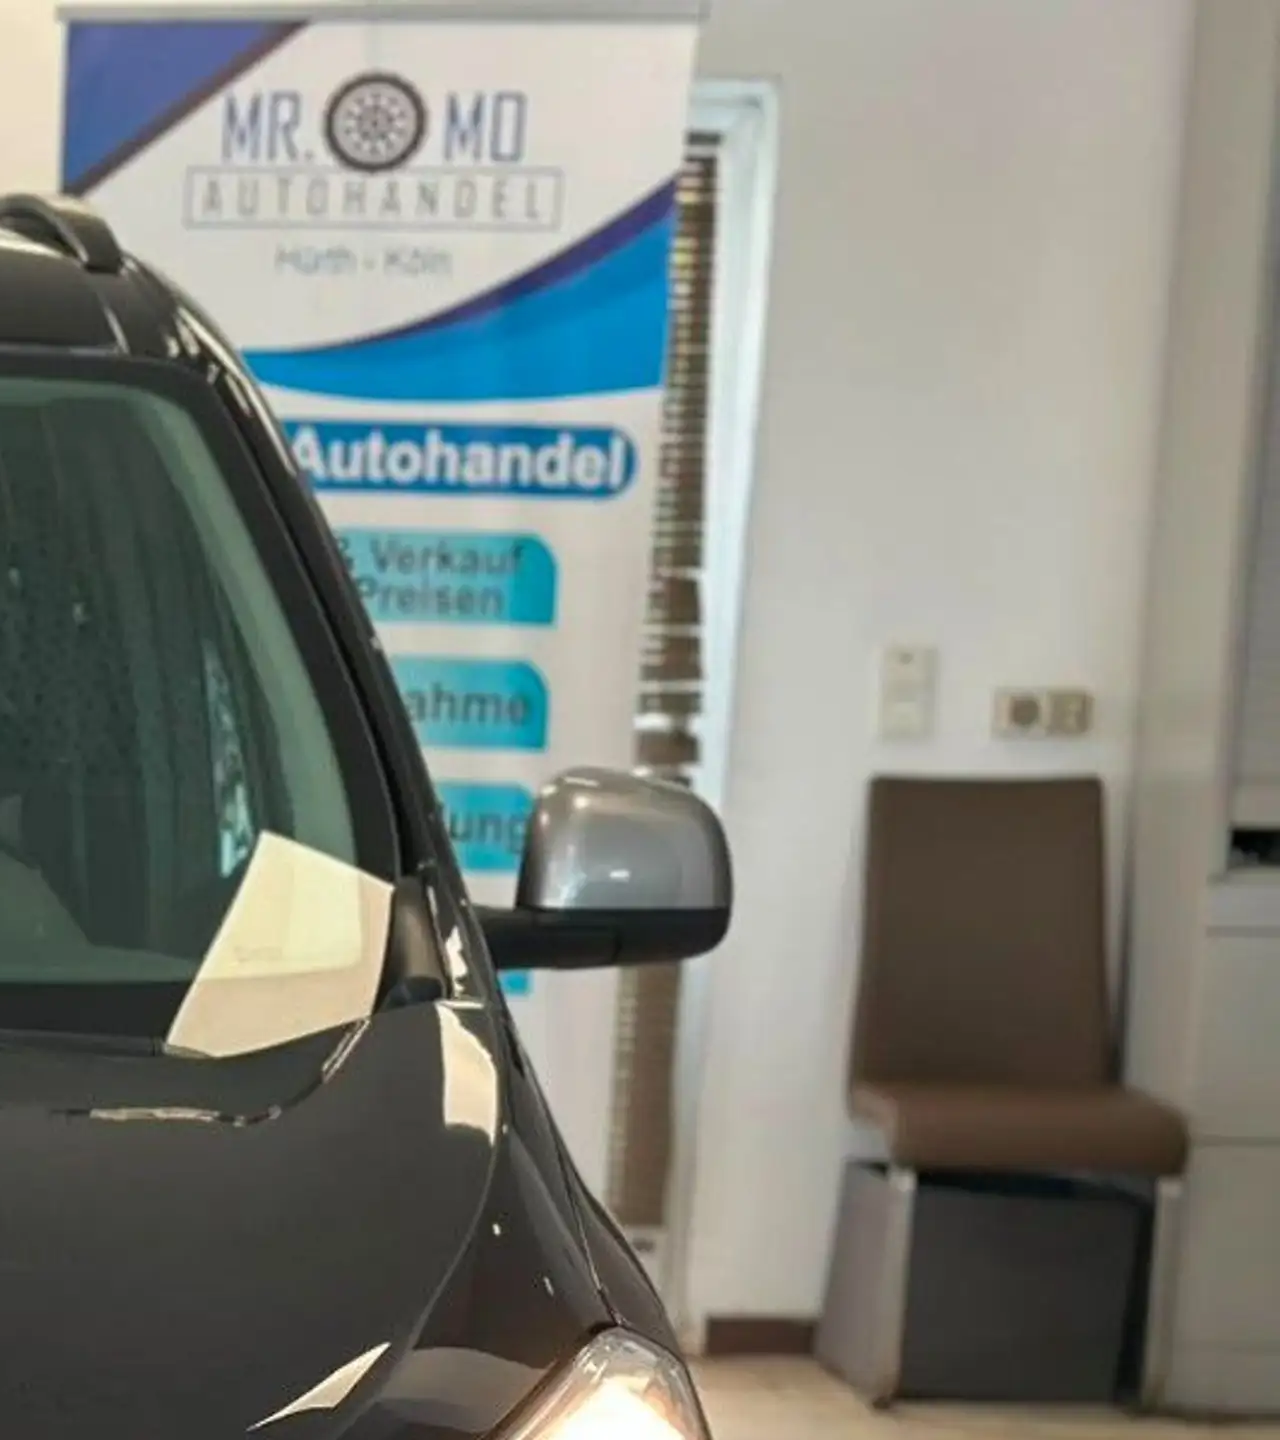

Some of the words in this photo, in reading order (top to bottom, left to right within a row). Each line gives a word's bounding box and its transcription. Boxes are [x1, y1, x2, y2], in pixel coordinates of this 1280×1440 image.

[221, 90, 314, 163] MR.
[443, 91, 528, 163] MO
[201, 176, 540, 219] AUTOHANDEL
[293, 424, 624, 487] Autohandel
[369, 538, 524, 575] Verkauf
